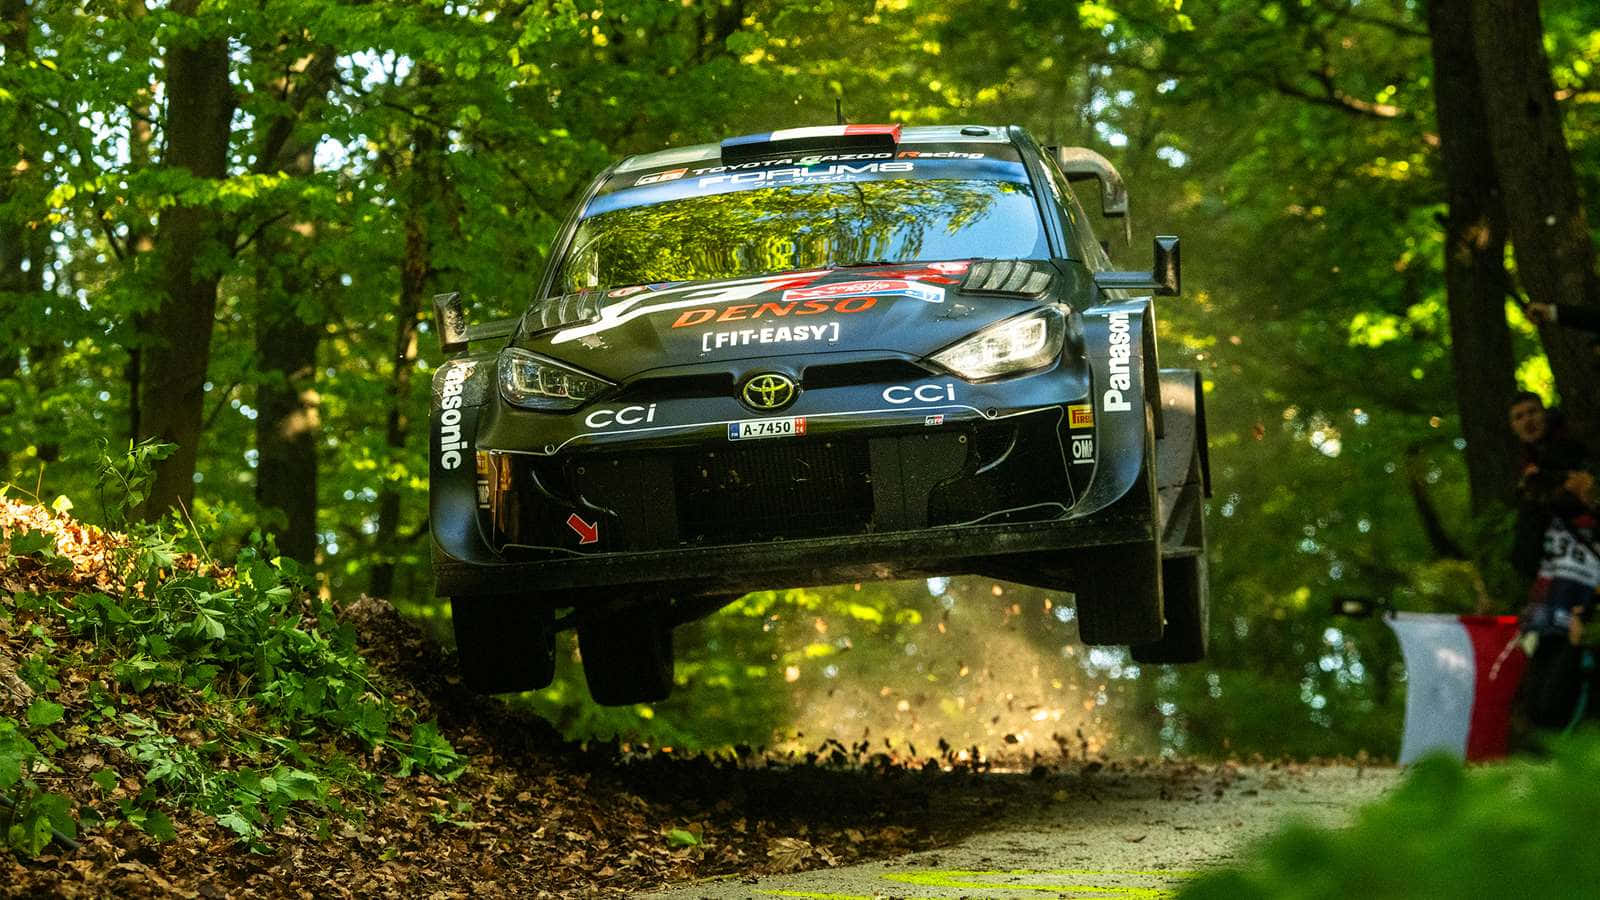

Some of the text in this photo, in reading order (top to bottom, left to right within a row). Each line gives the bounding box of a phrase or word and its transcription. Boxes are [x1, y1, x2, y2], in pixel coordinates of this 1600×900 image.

[692, 158, 793, 175] TOYOTA
[794, 152, 893, 165] GAZOO
[898, 151, 985, 160] Racing
[699, 162, 914, 189] FORUM8
[672, 297, 878, 329] DENSO
[743, 421, 792, 436] A-7450
